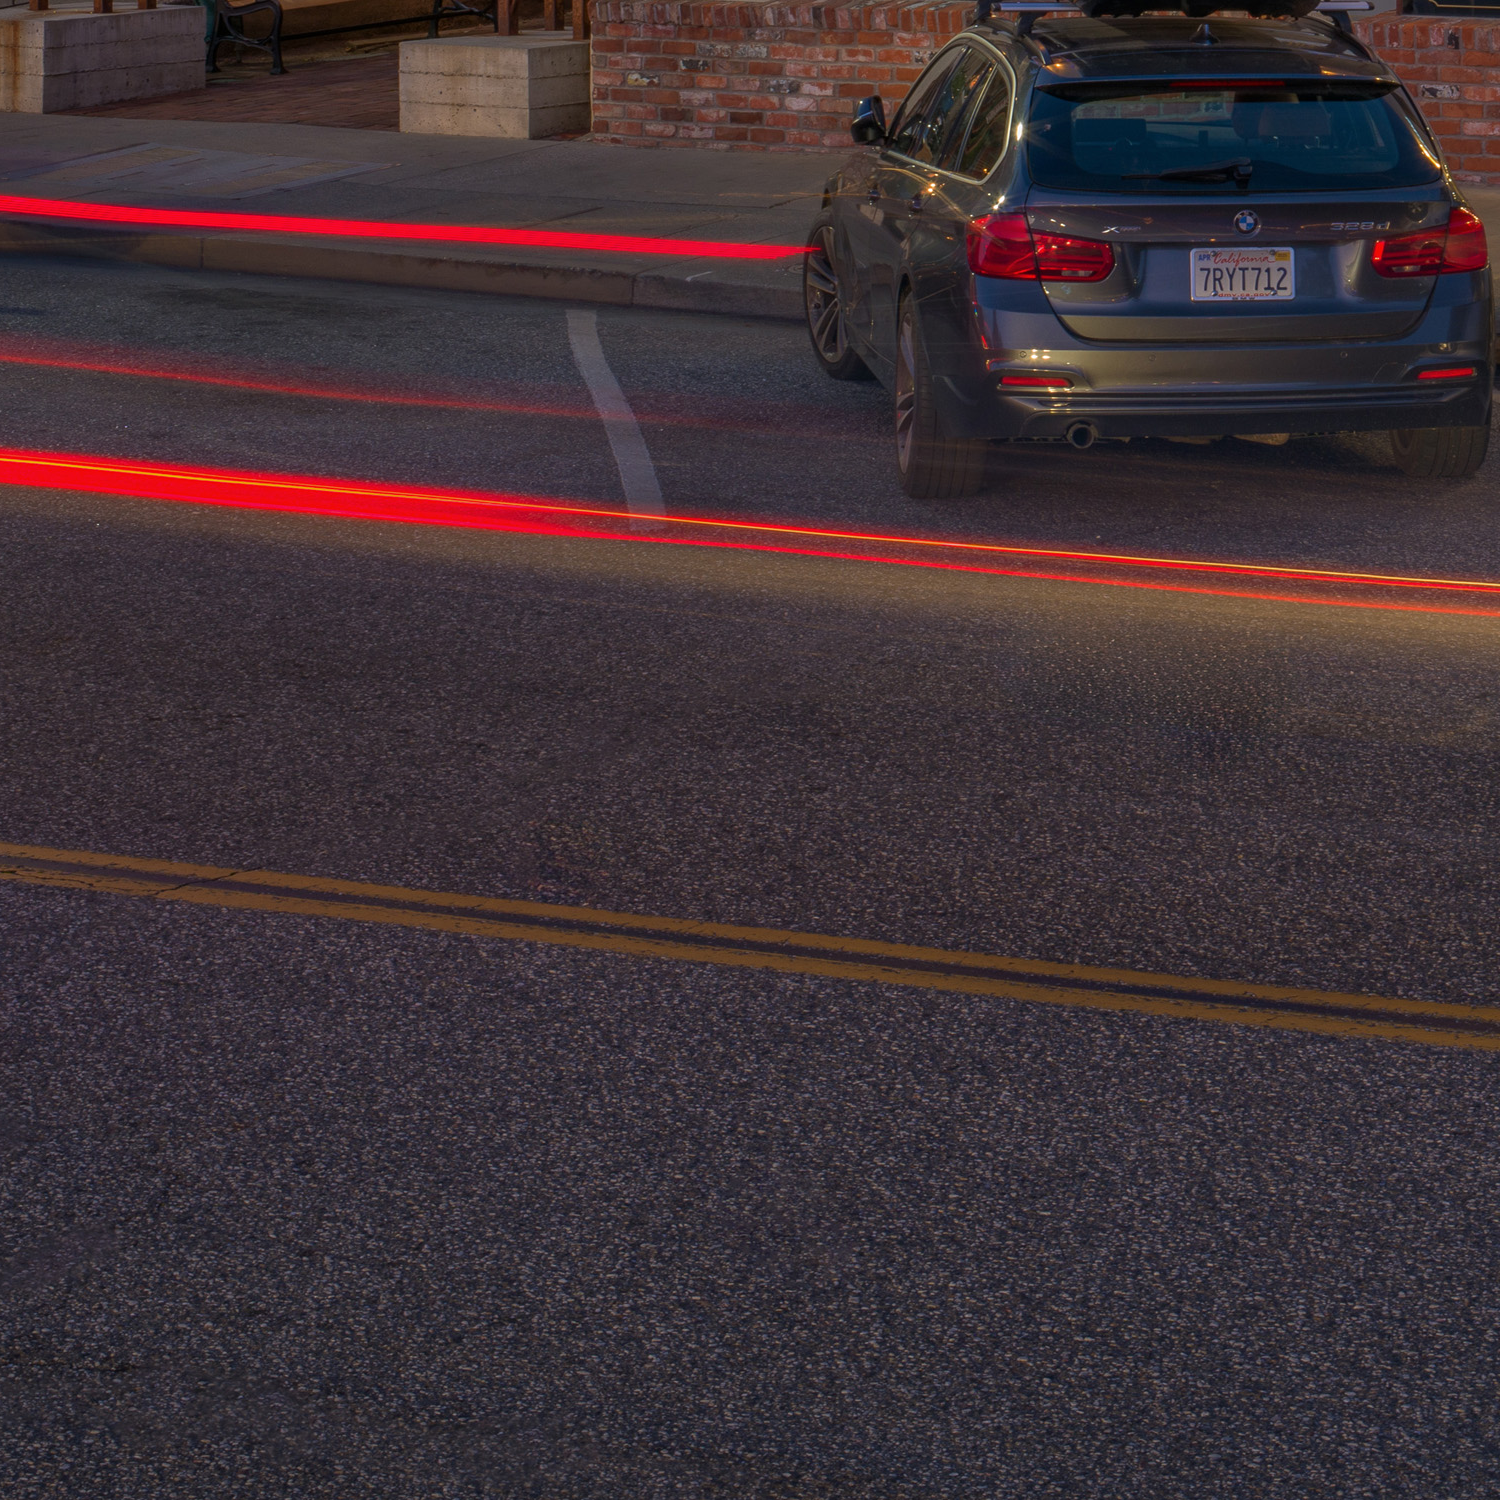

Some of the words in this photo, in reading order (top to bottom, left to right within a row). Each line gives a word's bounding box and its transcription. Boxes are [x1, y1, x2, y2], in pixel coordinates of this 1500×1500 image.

[1330, 221, 1391, 231] 328d
[1213, 251, 1276, 267] California
[1199, 267, 1287, 291] 7RYT712
